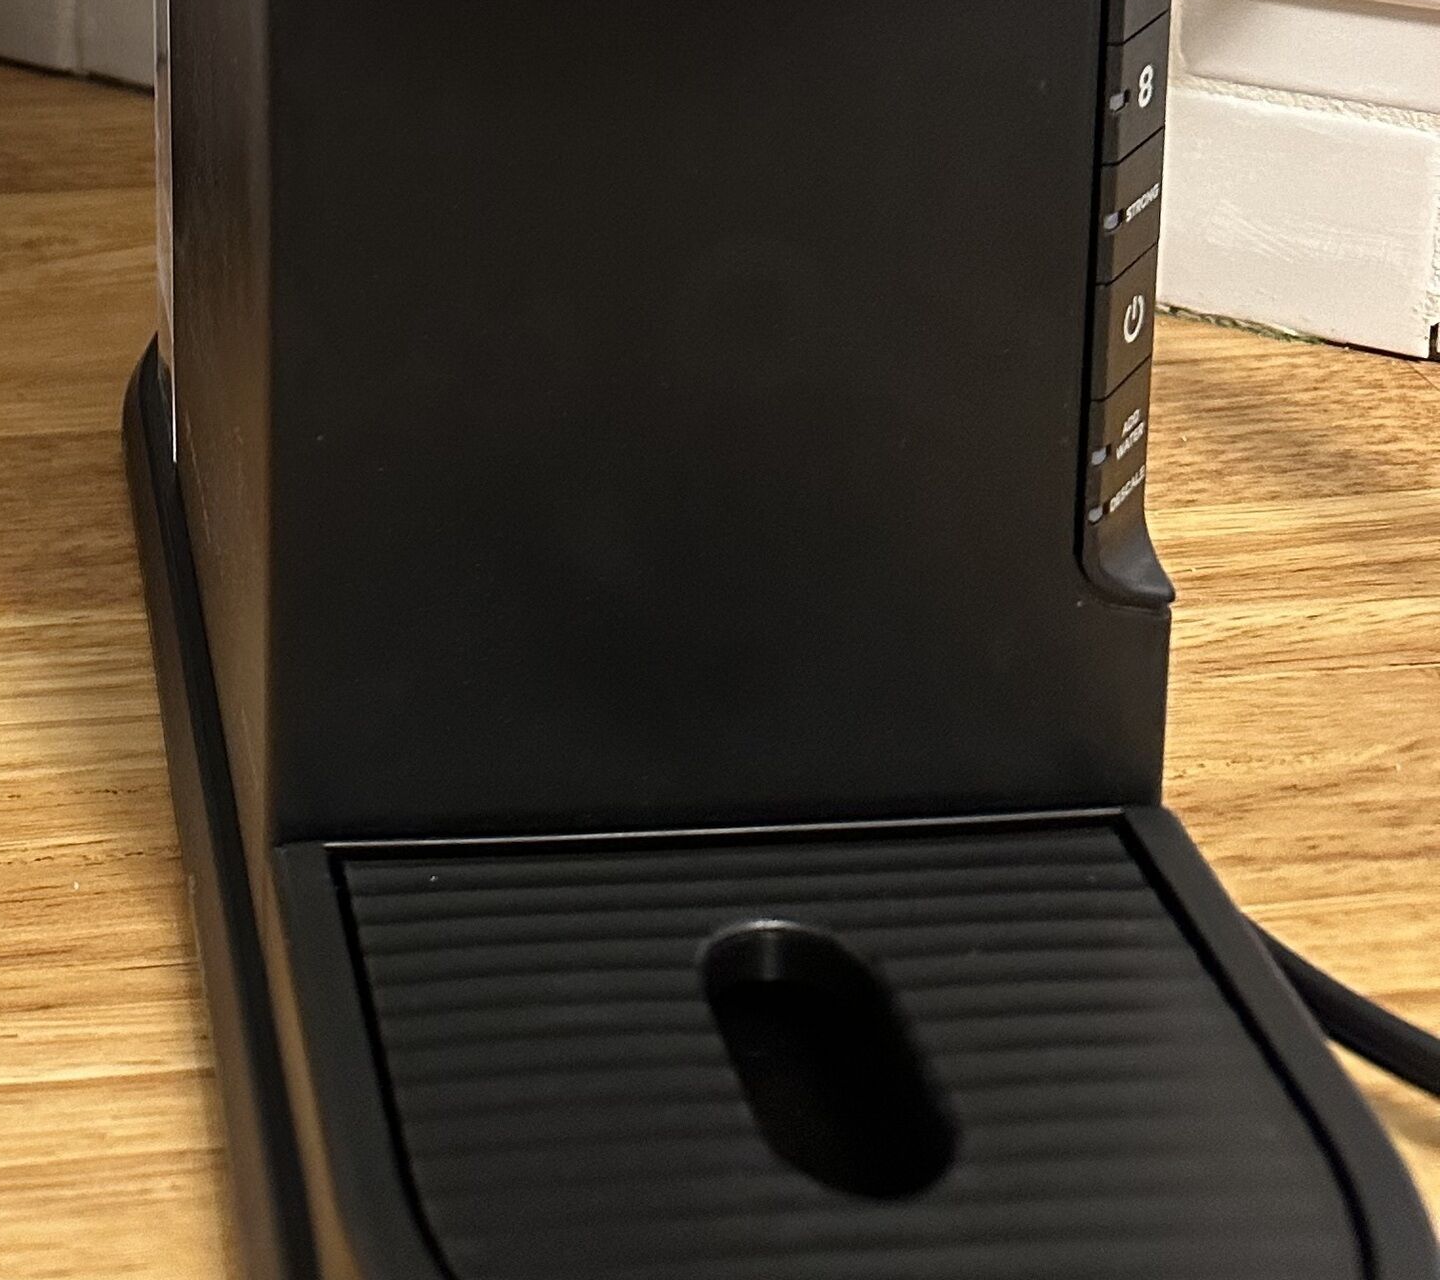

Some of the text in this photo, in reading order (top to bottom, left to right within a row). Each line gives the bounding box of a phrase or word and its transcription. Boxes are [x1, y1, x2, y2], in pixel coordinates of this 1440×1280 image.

[1137, 64, 1153, 109] 8
[1125, 182, 1159, 223] STRONG
[1109, 464, 1146, 514] DESCALE
